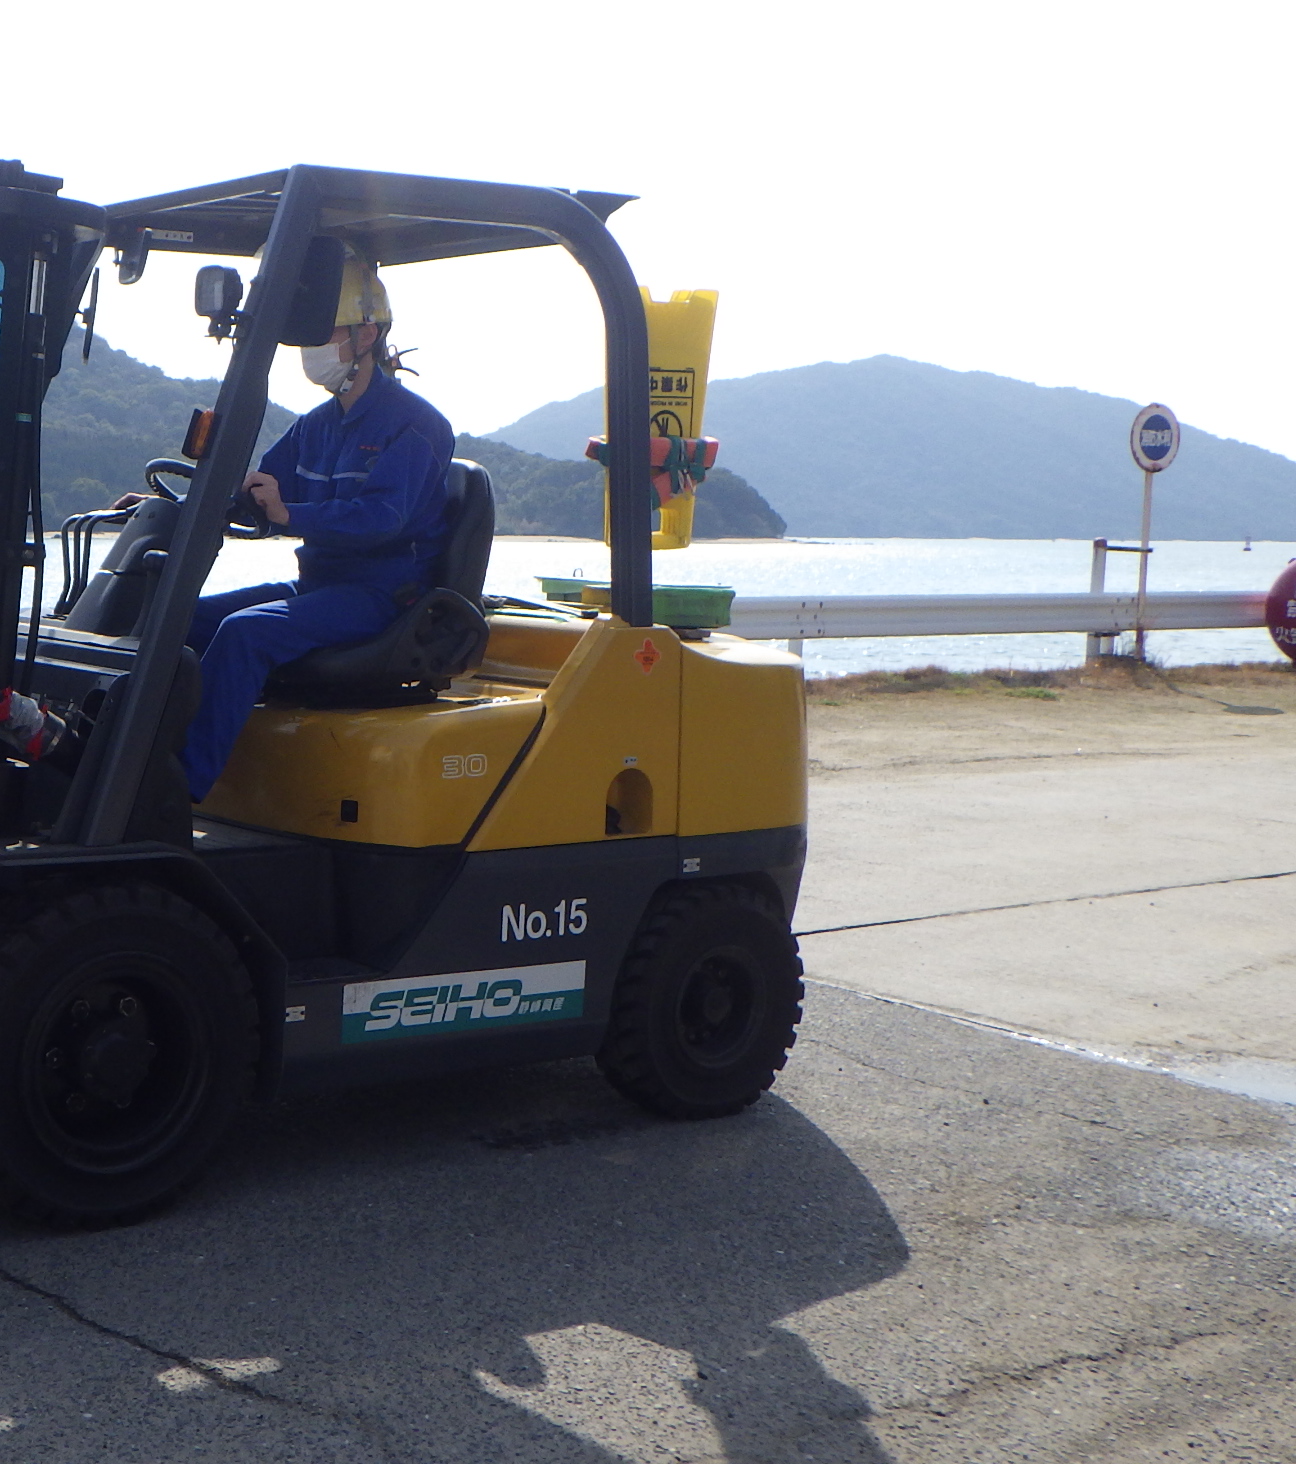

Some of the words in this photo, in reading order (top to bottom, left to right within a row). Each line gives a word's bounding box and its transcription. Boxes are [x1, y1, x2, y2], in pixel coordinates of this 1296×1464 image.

[441, 753, 488, 779] 30
[501, 898, 588, 942] No.15
[364, 979, 523, 1032] SEIHO
